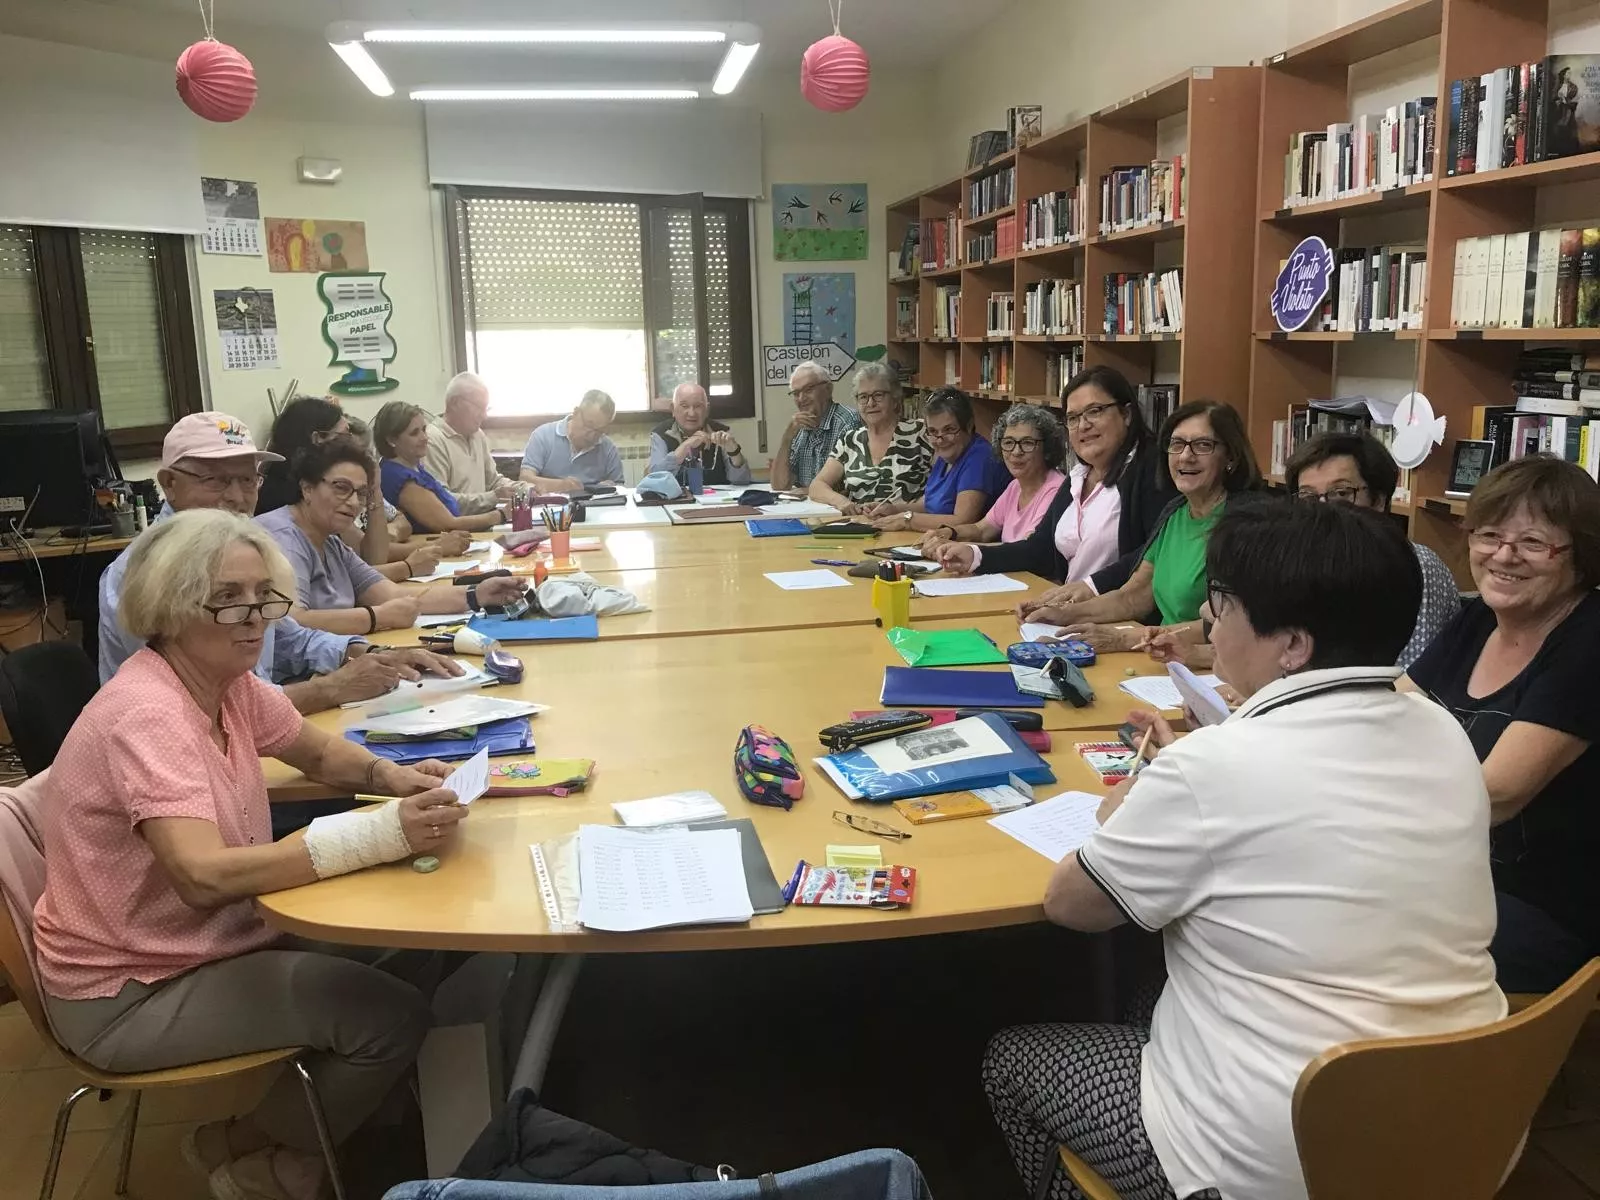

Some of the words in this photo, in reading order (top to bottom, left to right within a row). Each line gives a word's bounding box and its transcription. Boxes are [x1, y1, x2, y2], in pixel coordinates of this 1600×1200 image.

[1288, 251, 1321, 284] Punto
[1279, 280, 1315, 313] Violeta
[328, 303, 390, 322] RESPONSABLE
[350, 322, 377, 336] PAPEL
[766, 344, 830, 362] Castejón
[767, 365, 787, 380] del
